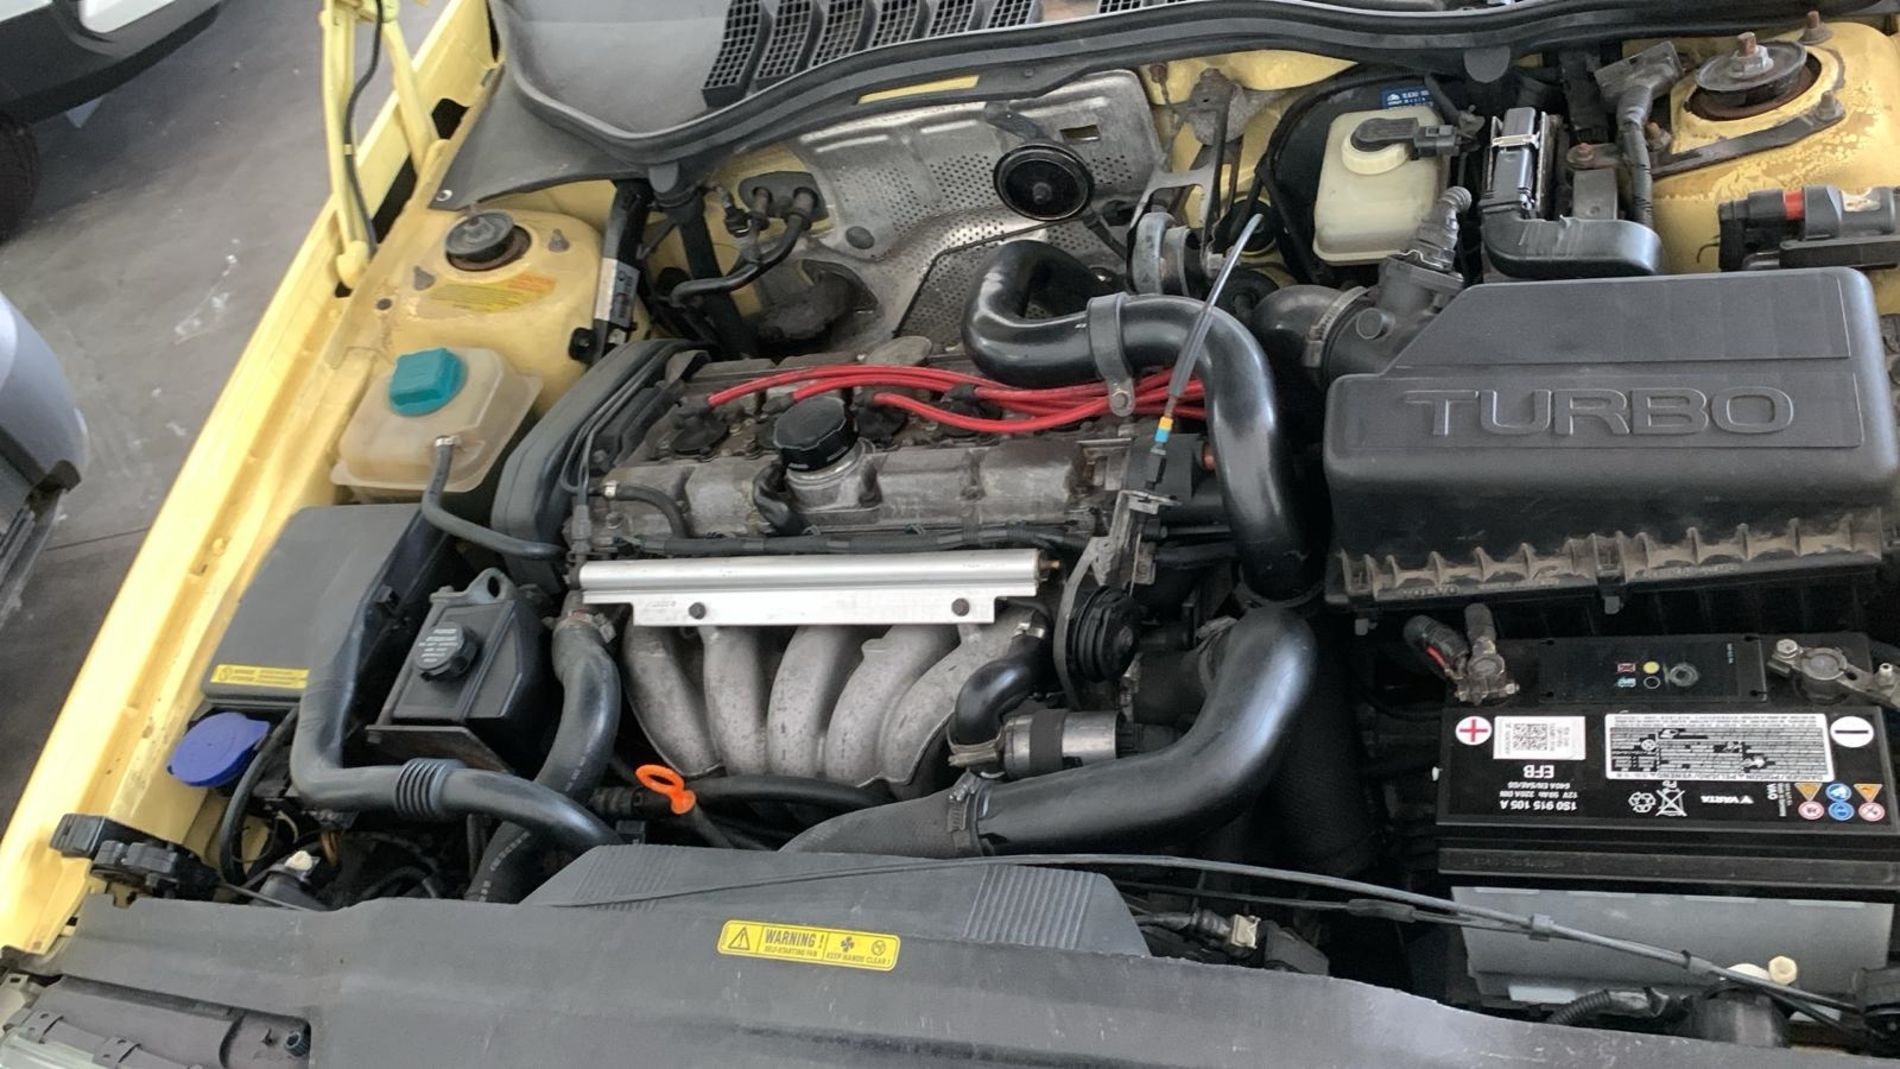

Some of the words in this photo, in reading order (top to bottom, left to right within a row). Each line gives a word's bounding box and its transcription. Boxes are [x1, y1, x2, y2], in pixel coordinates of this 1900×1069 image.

[1403, 385, 1795, 436] TURBO
[1523, 765, 1555, 779] EFB
[1562, 791, 1578, 799] 12V
[1700, 795, 1740, 804] VARTA
[1500, 800, 1509, 809] A
[1510, 800, 1531, 810] 105
[1533, 800, 1555, 811] 915
[764, 929, 816, 948] WARNING
[843, 953, 865, 963] HANDS
[866, 955, 886, 964] CLEAR
